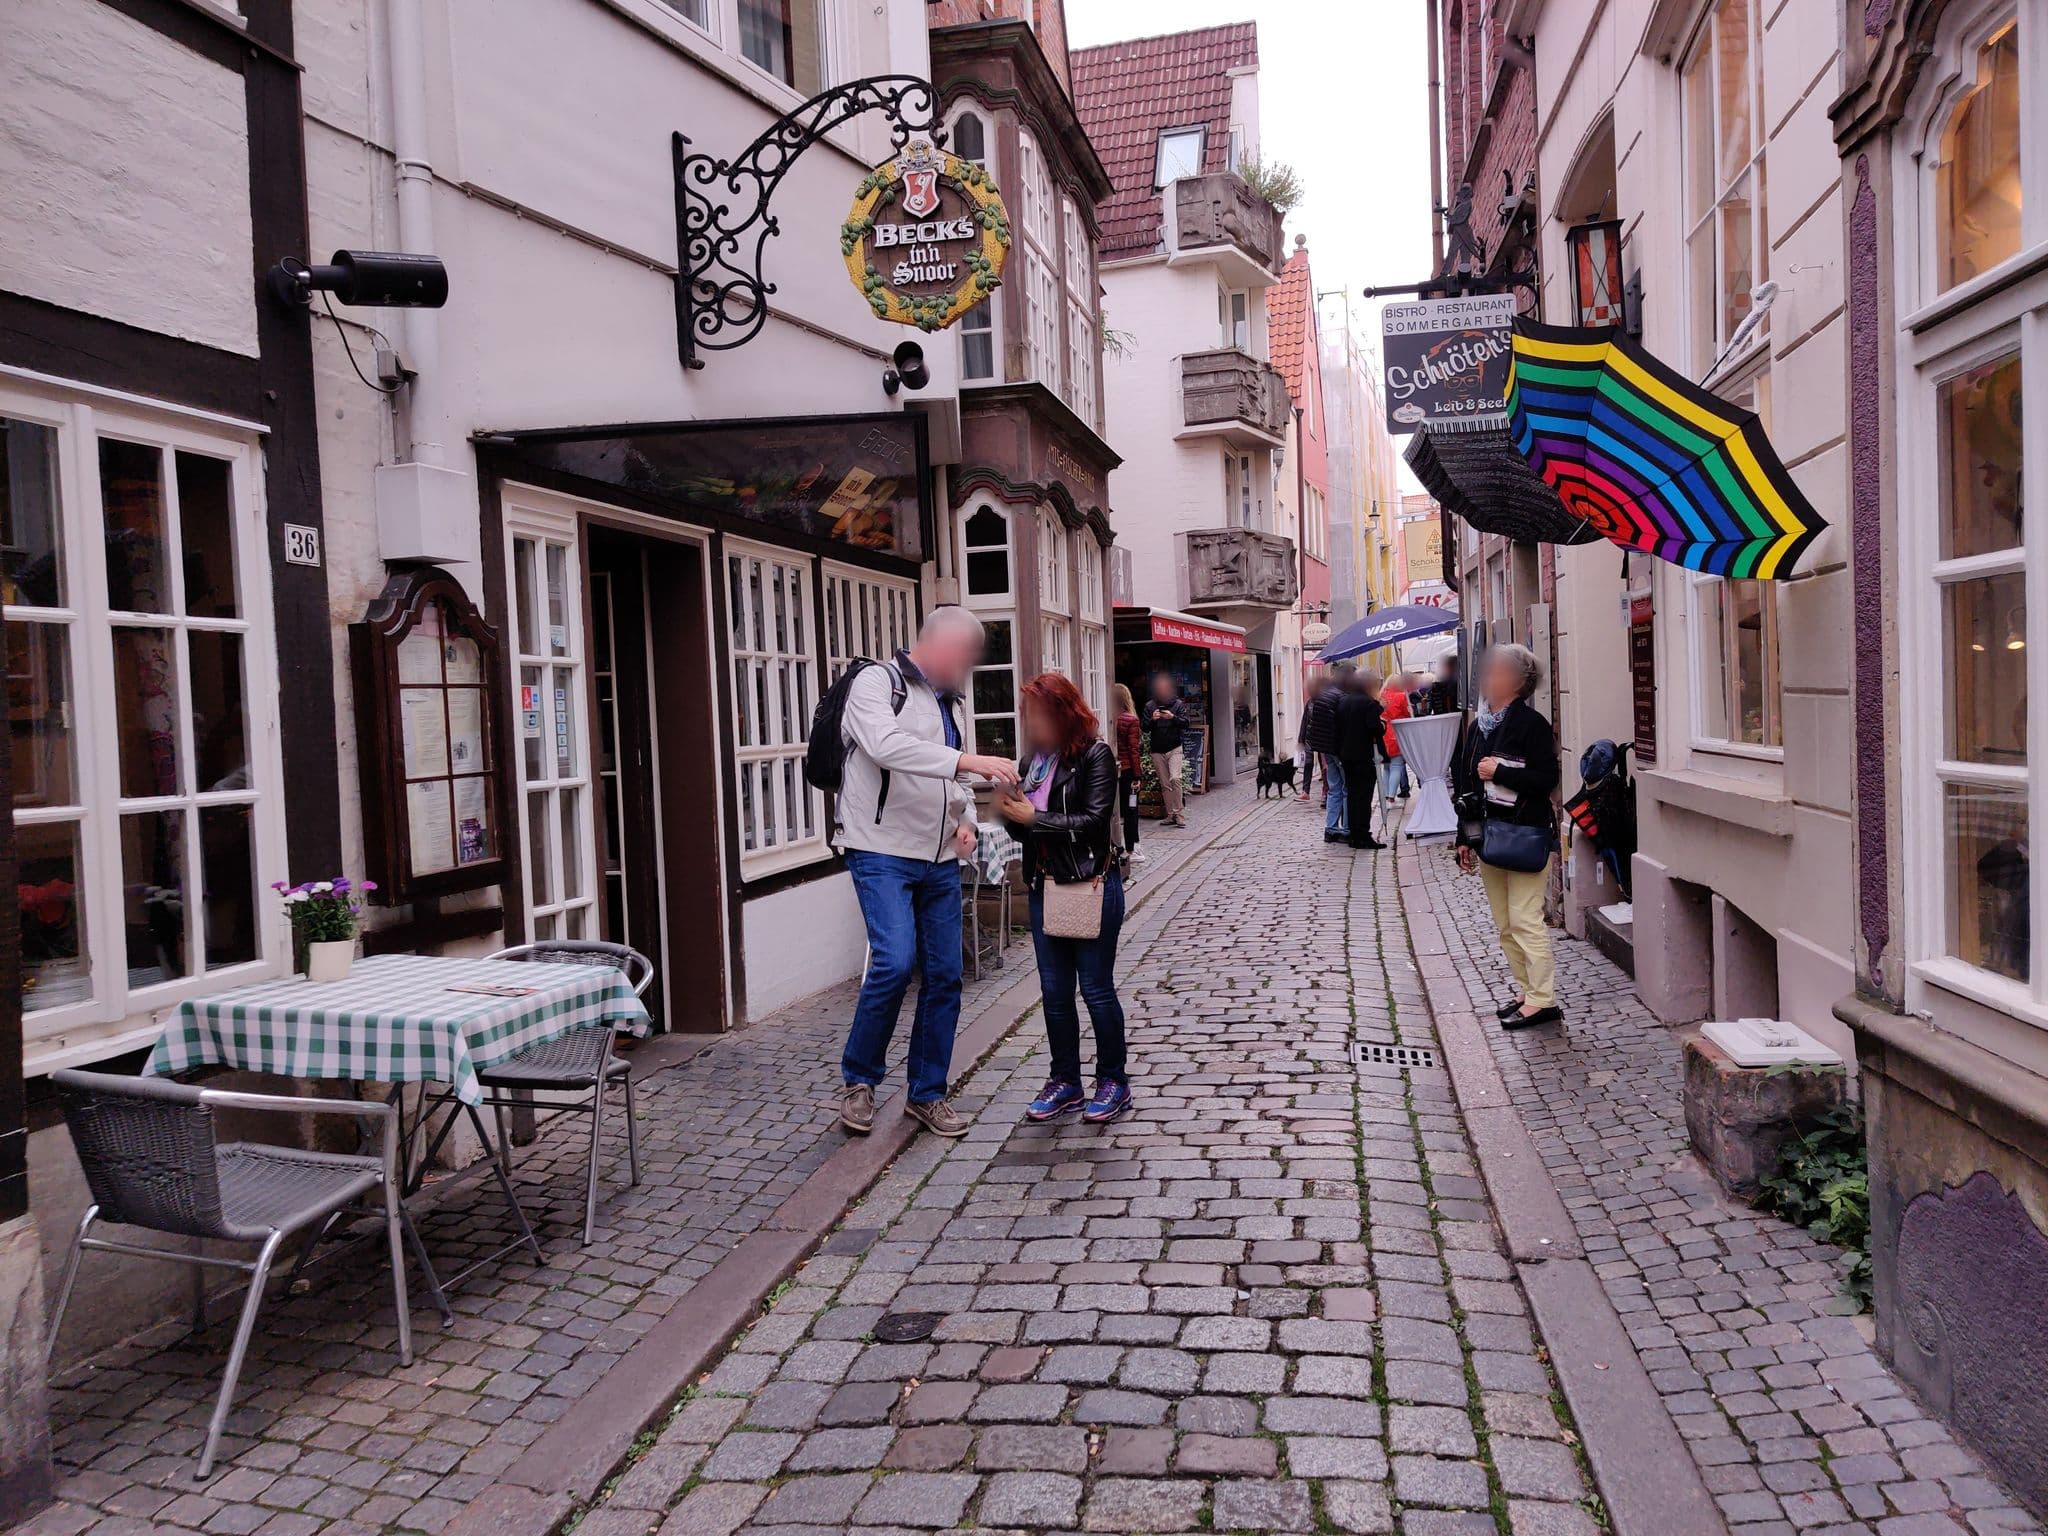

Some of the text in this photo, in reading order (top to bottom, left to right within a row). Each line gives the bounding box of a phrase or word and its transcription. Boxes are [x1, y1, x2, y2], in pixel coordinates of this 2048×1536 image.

[873, 216, 975, 248] BECK'S
[893, 262, 958, 286] Snoor
[1385, 299, 1514, 319] BISTRO RESTAURANT
[1385, 313, 1513, 333] SOMMERGARTEN
[1434, 400, 1464, 413] Leib
[1466, 399, 1475, 410] &
[1478, 397, 1508, 410] Seel
[291, 530, 316, 560] 36
[1414, 593, 1442, 608] EIS
[1365, 618, 1406, 637] VILSA
